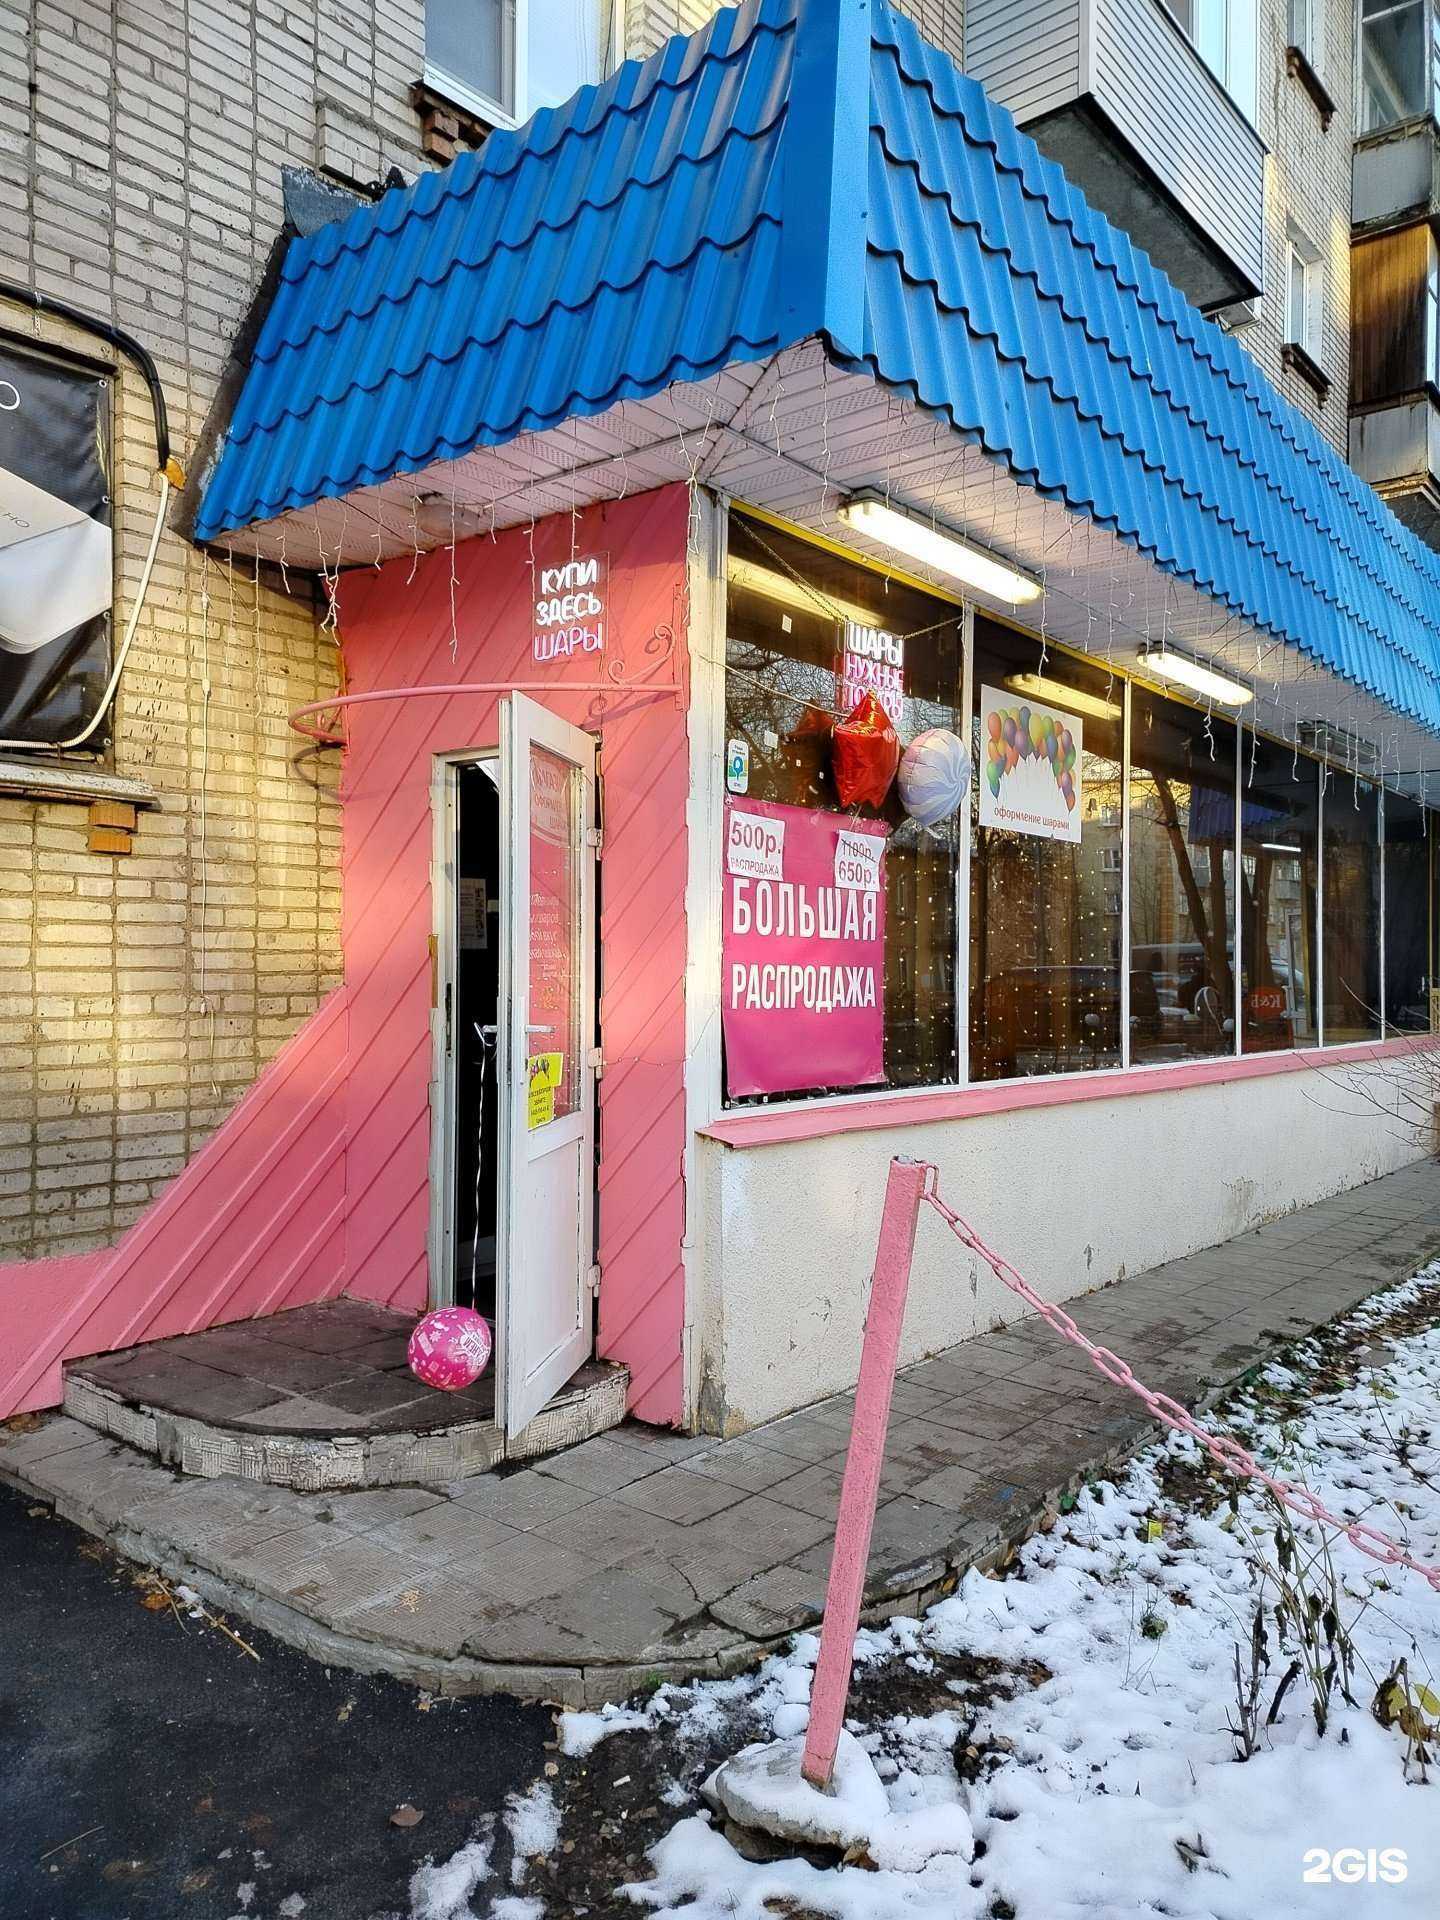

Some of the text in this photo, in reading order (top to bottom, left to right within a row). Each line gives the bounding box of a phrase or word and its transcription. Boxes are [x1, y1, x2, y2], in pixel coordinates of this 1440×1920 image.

[541, 558, 598, 595] КУПИ
[535, 592, 603, 627] ЗДЕСЬ
[533, 623, 603, 661] ШАРЫ
[846, 621, 904, 667] ШАРЫ
[846, 653, 905, 692] НУЖНЫЕ
[844, 681, 904, 721] ТОРЫ
[994, 805, 1070, 831] оформление шарами
[731, 820, 782, 858] 500р.
[729, 857, 780, 877] РАСПРОДАЖА
[838, 860, 876, 887] 650р.
[732, 878, 878, 942] БОЛЬШАЯ
[731, 963, 877, 1014] РАСПРОДАЖА
